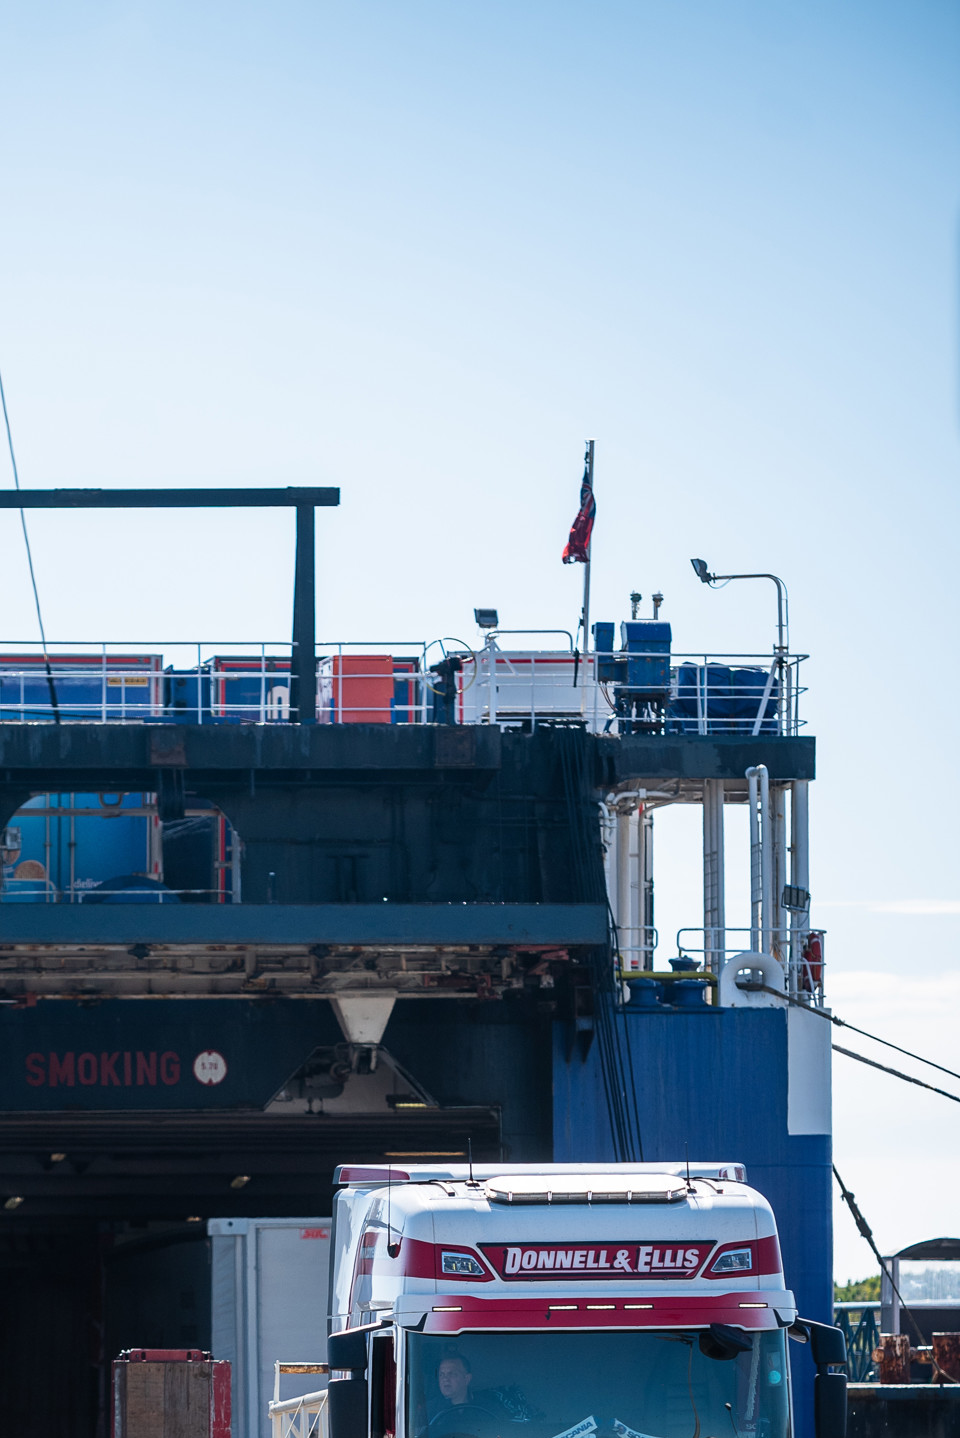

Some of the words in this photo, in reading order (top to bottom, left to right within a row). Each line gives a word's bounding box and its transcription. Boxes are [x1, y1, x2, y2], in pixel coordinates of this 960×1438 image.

[26, 1051, 181, 1087] SMOKING
[504, 1247, 611, 1274] DONNELL
[613, 1249, 635, 1273] &
[637, 1246, 700, 1273] ELLIS
